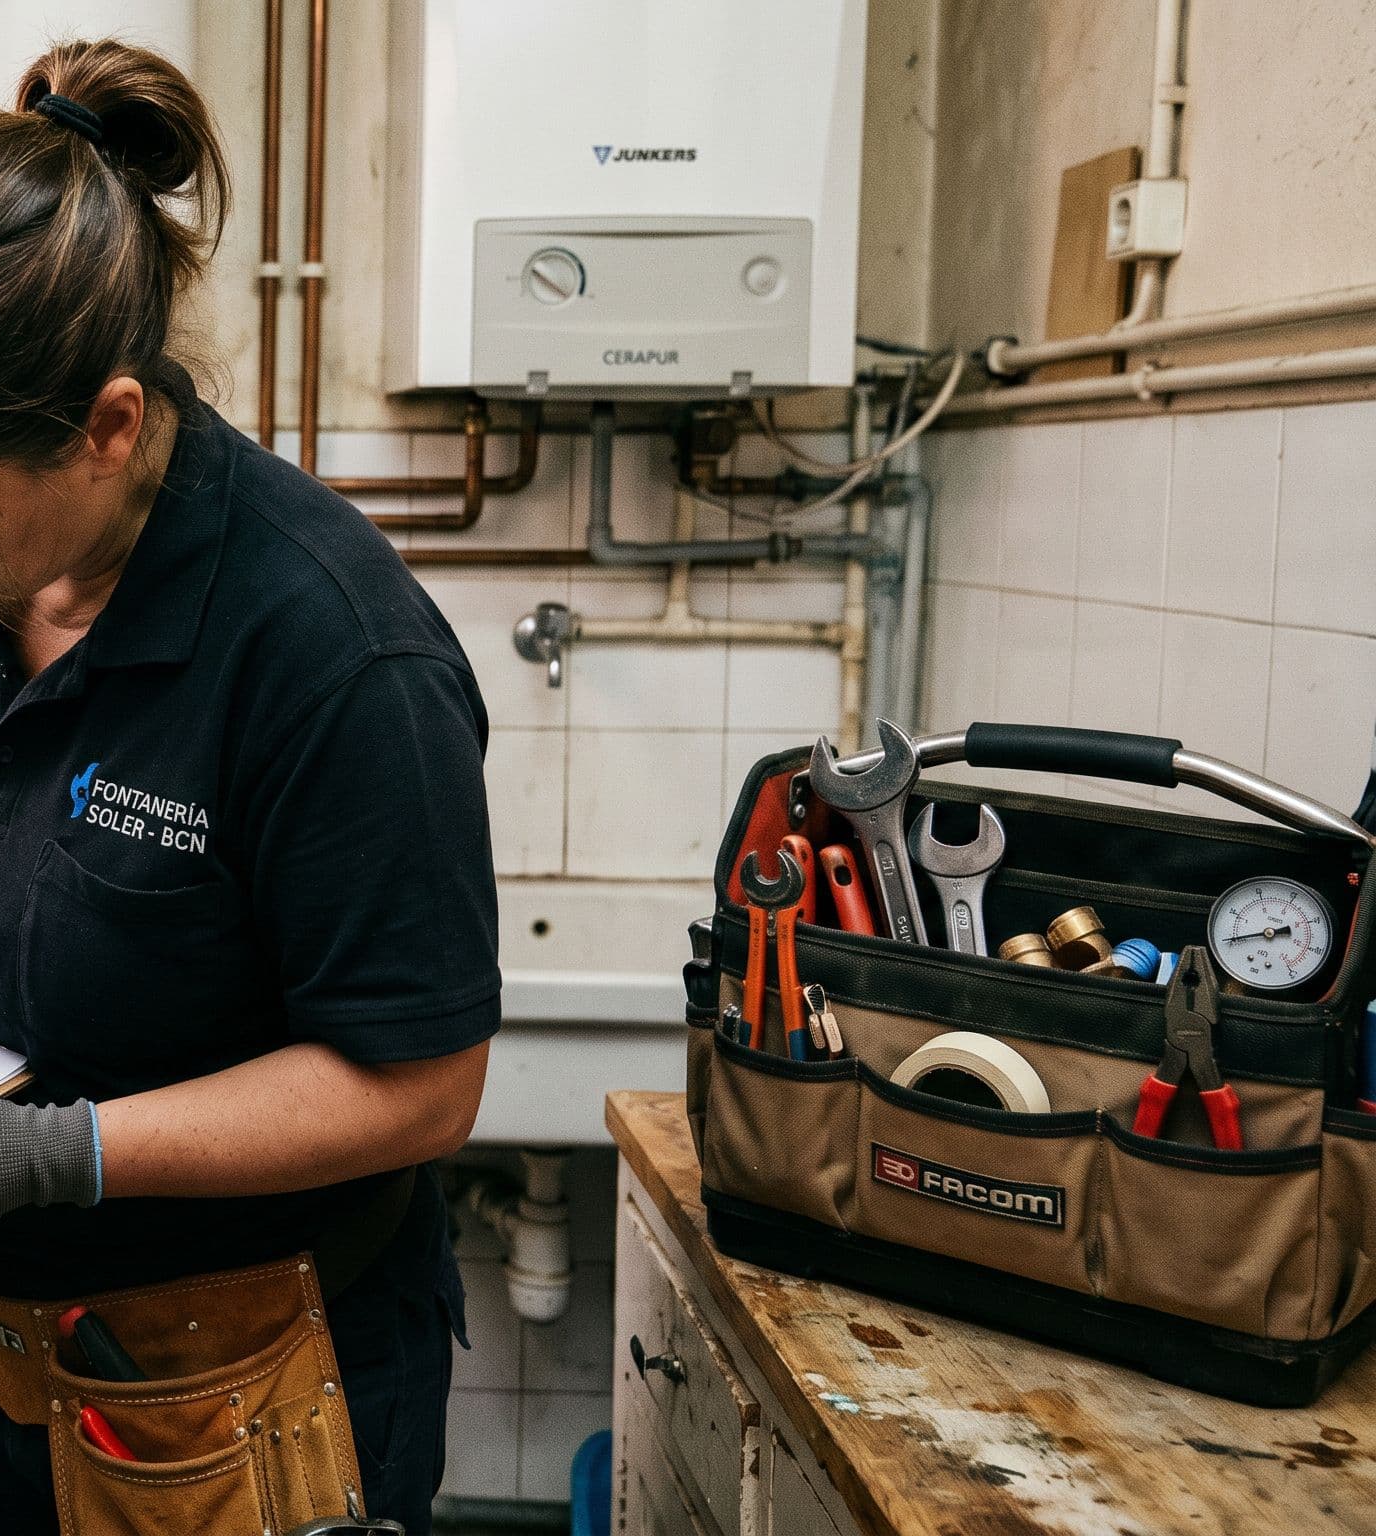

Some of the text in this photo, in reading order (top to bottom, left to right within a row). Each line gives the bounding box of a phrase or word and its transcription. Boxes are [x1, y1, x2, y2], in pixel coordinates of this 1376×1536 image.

[614, 147, 697, 163] JUNKERS
[602, 349, 680, 366] CERAPUR
[91, 778, 210, 830] FONTANERÍA
[86, 804, 144, 841] SOLER
[160, 829, 206, 854] BCN
[922, 1170, 1054, 1216] FACOM
